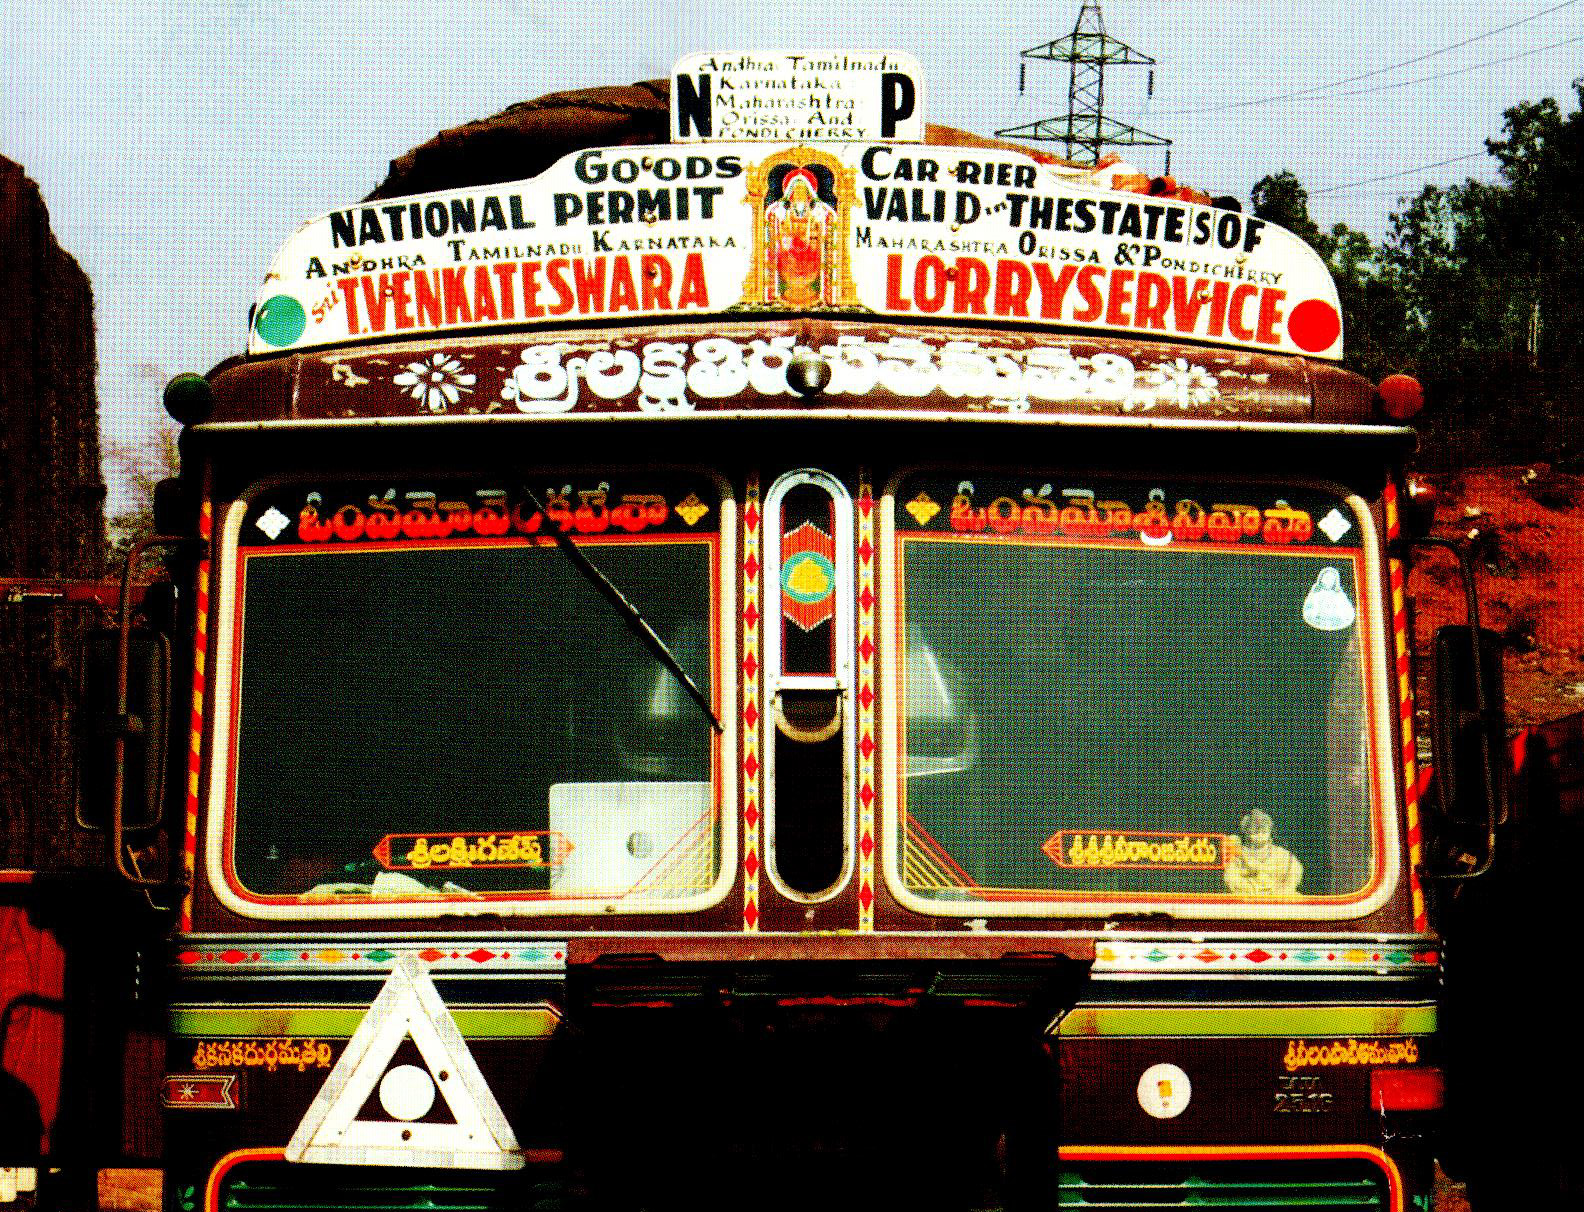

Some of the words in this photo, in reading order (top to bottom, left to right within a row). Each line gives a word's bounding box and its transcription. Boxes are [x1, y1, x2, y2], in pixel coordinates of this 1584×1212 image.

[698, 57, 774, 72] Andhra
[785, 55, 899, 72] Tamilnadu
[720, 76, 841, 90] Karnataka
[677, 74, 713, 137] N
[715, 94, 855, 109] Maharashtra
[721, 111, 789, 126] Orissa
[808, 111, 853, 125] And
[881, 72, 915, 138] P
[574, 150, 743, 184] GOODS
[329, 195, 536, 248] NATIONAL
[553, 186, 724, 226] PERMIT
[863, 187, 982, 224] VALID
[1018, 230, 1100, 264] ORISSA
